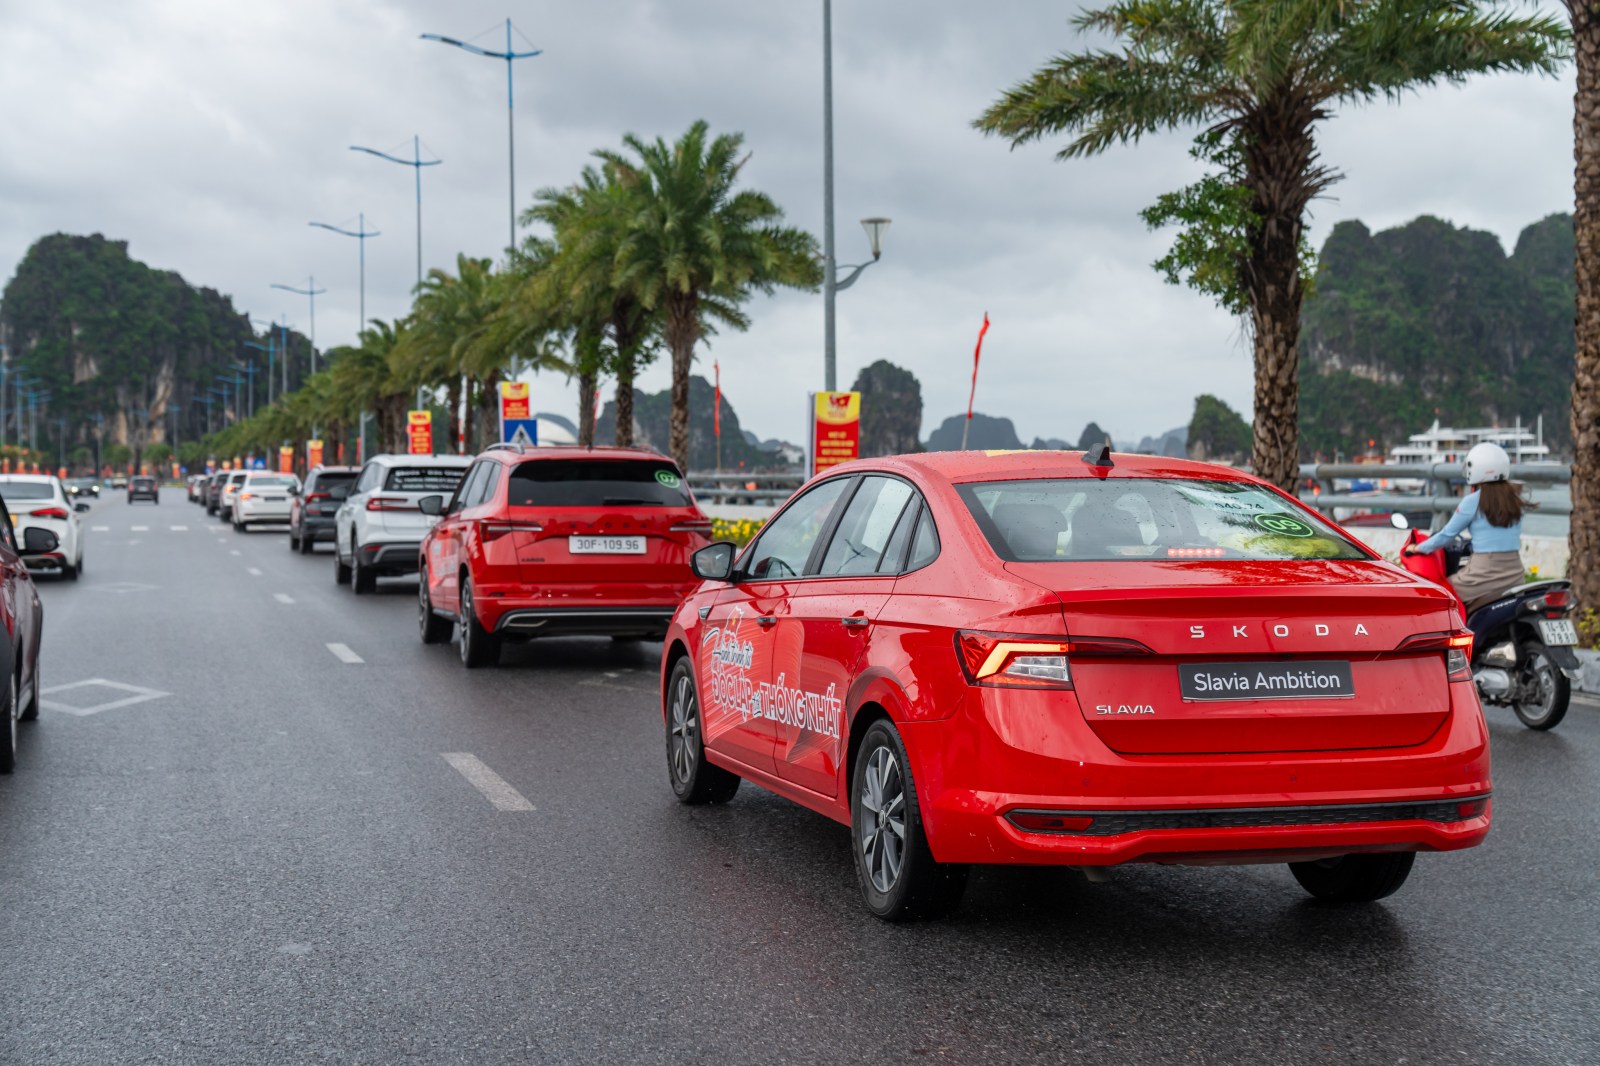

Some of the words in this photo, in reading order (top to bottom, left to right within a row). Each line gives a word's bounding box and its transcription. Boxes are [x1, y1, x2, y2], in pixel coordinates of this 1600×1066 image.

[1263, 519, 1302, 531] 09
[577, 539, 639, 551] 30F-109.96
[1190, 624, 1369, 640] SKODA
[1193, 672, 1250, 692] Slavia
[1254, 670, 1341, 691] Ambition
[712, 663, 736, 714] ĐỘC
[735, 667, 753, 722] LẬP
[759, 672, 806, 729] THỐNG
[805, 682, 841, 739] NHẤT
[1096, 705, 1156, 716] SLAVIA
